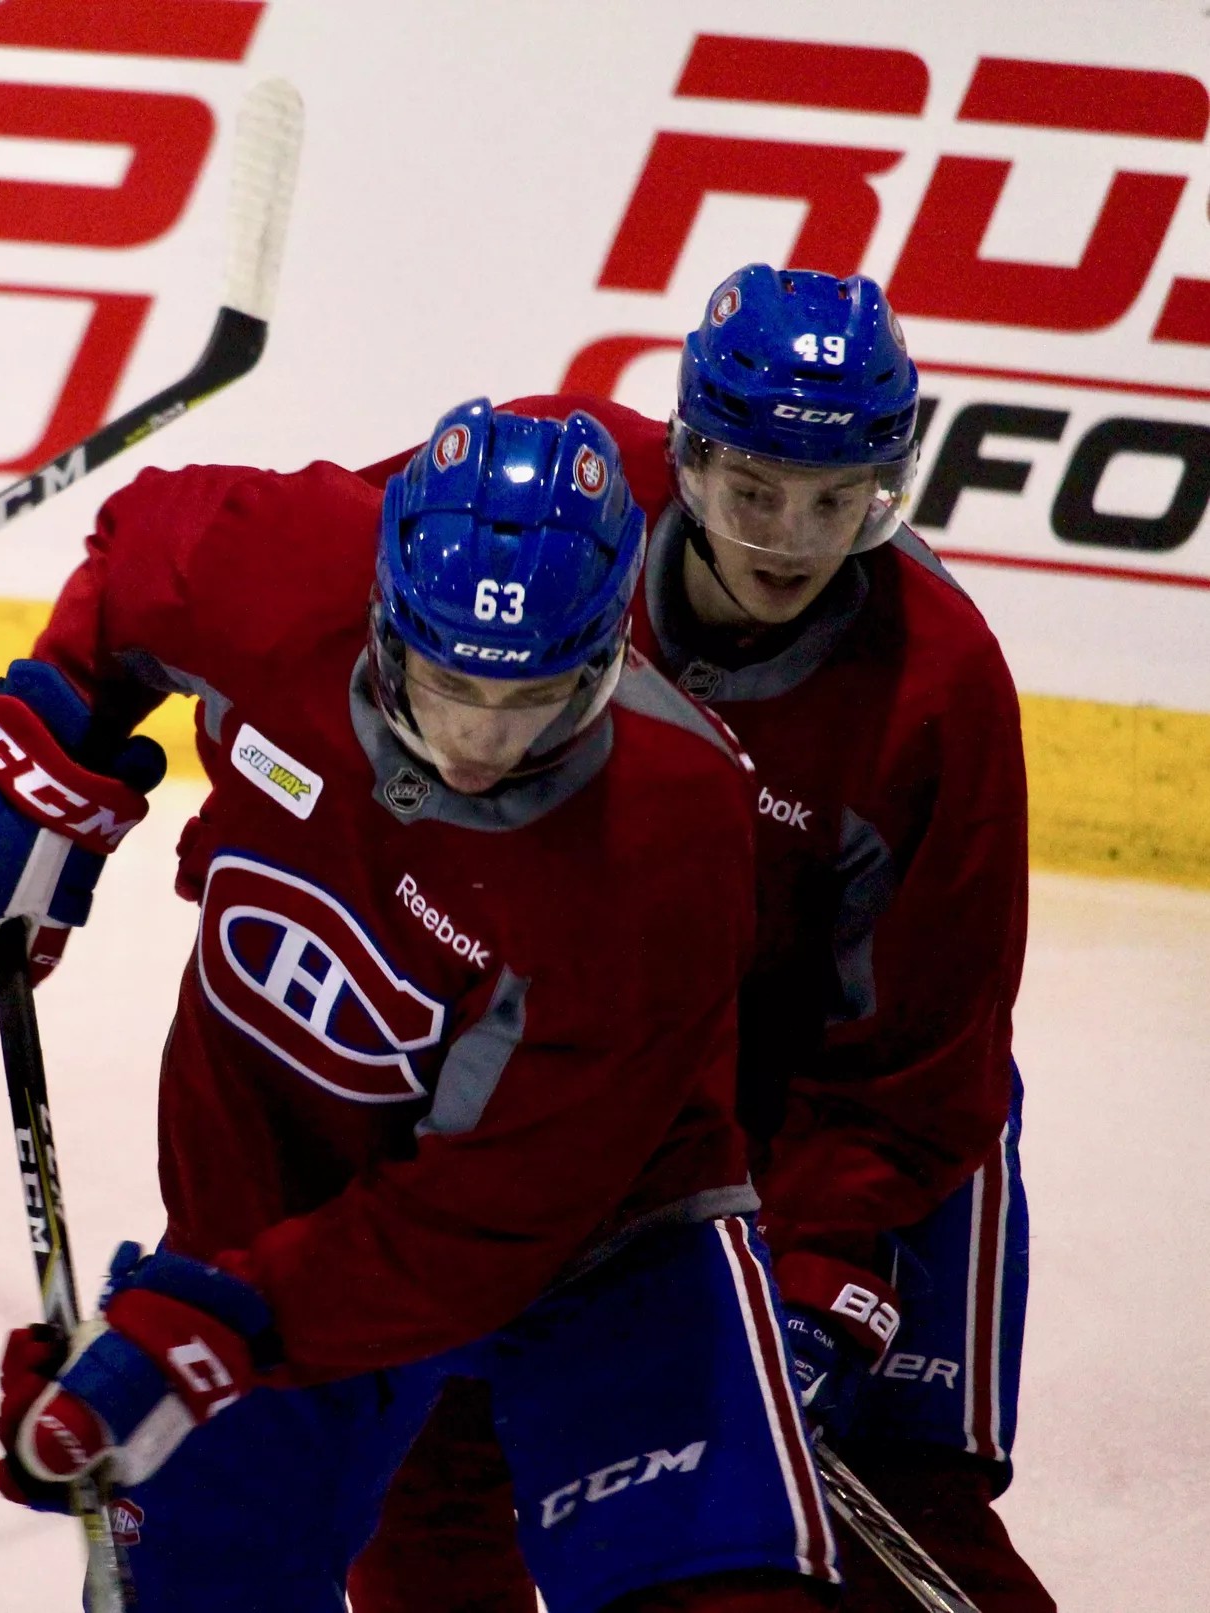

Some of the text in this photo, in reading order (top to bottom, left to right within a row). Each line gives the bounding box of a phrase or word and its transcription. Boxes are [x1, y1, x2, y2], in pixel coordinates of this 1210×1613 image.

[595, 33, 1210, 344] RD
[793, 332, 846, 366] 49
[772, 403, 854, 426] CCM
[474, 579, 525, 624] 63
[454, 642, 531, 662] CCM
[239, 744, 312, 801] SUBWAY
[395, 872, 490, 970] Reebok
[15, 1128, 52, 1253] CCM
[540, 1440, 707, 1529] CCM
